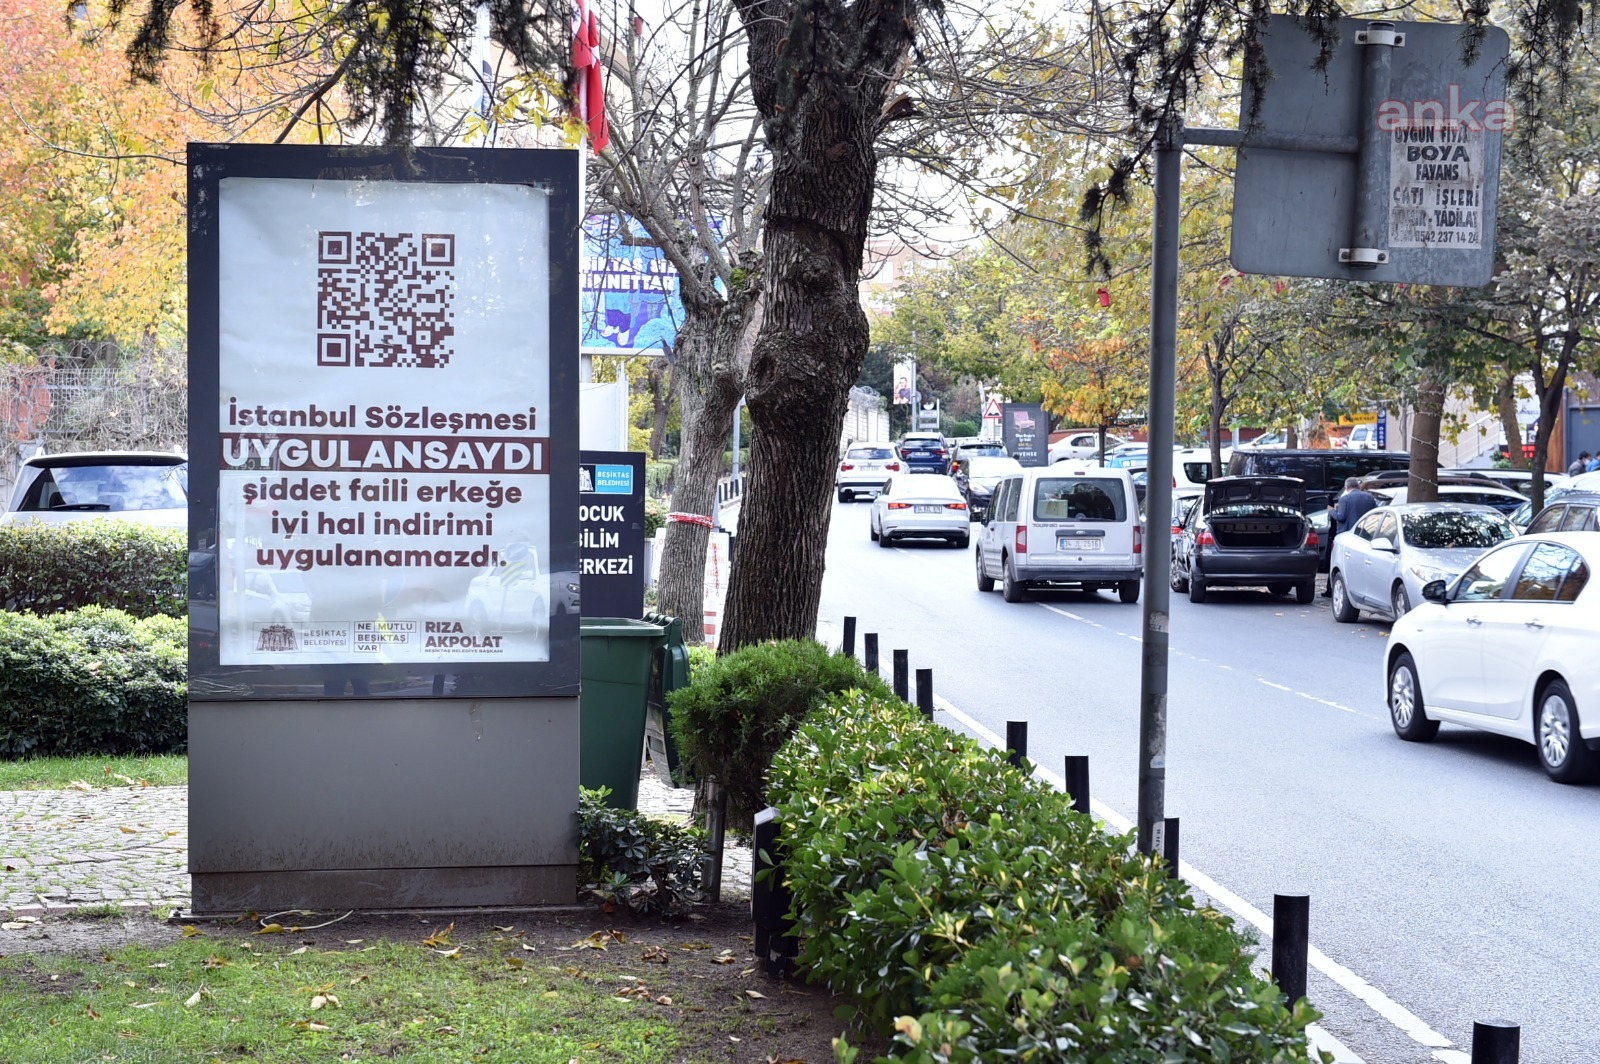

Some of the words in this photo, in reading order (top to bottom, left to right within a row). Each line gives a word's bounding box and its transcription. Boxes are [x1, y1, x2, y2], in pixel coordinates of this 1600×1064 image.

[1394, 126, 1434, 143] UYGUN
[1441, 123, 1469, 143] FİYA
[1407, 146, 1470, 162] BOYA
[1416, 164, 1459, 180] FAYANS
[1436, 184, 1479, 209] İŞLERİ
[1437, 231, 1454, 243] 237
[1456, 231, 1466, 243] 14
[580, 256, 643, 273] ŞİKTAŞ
[229, 396, 356, 428] İstanbul
[365, 405, 536, 434] Sözleşmesi
[222, 438, 542, 470] UYGULANSAYDI
[597, 470, 630, 479] BEŞİKTAŞ
[242, 476, 341, 505] şiddet
[349, 478, 408, 502] faili
[416, 480, 522, 508] erkeğe
[579, 505, 625, 522] OCUK
[271, 510, 308, 539] iyi
[318, 511, 364, 535] hal
[374, 511, 493, 536] indirimi
[256, 543, 507, 571] uygulanamazdı.
[579, 555, 633, 575] RKEZİ
[303, 629, 347, 638] BEŞİKTAŞ
[357, 622, 372, 631] NE
[377, 622, 413, 631] MUTLU
[425, 621, 463, 634] RIZA
[303, 638, 347, 646] BELEDİYESİ
[357, 633, 406, 643] BEŞİKTAŞ
[424, 635, 503, 648] AKPOLAT
[357, 644, 378, 652] VAR
